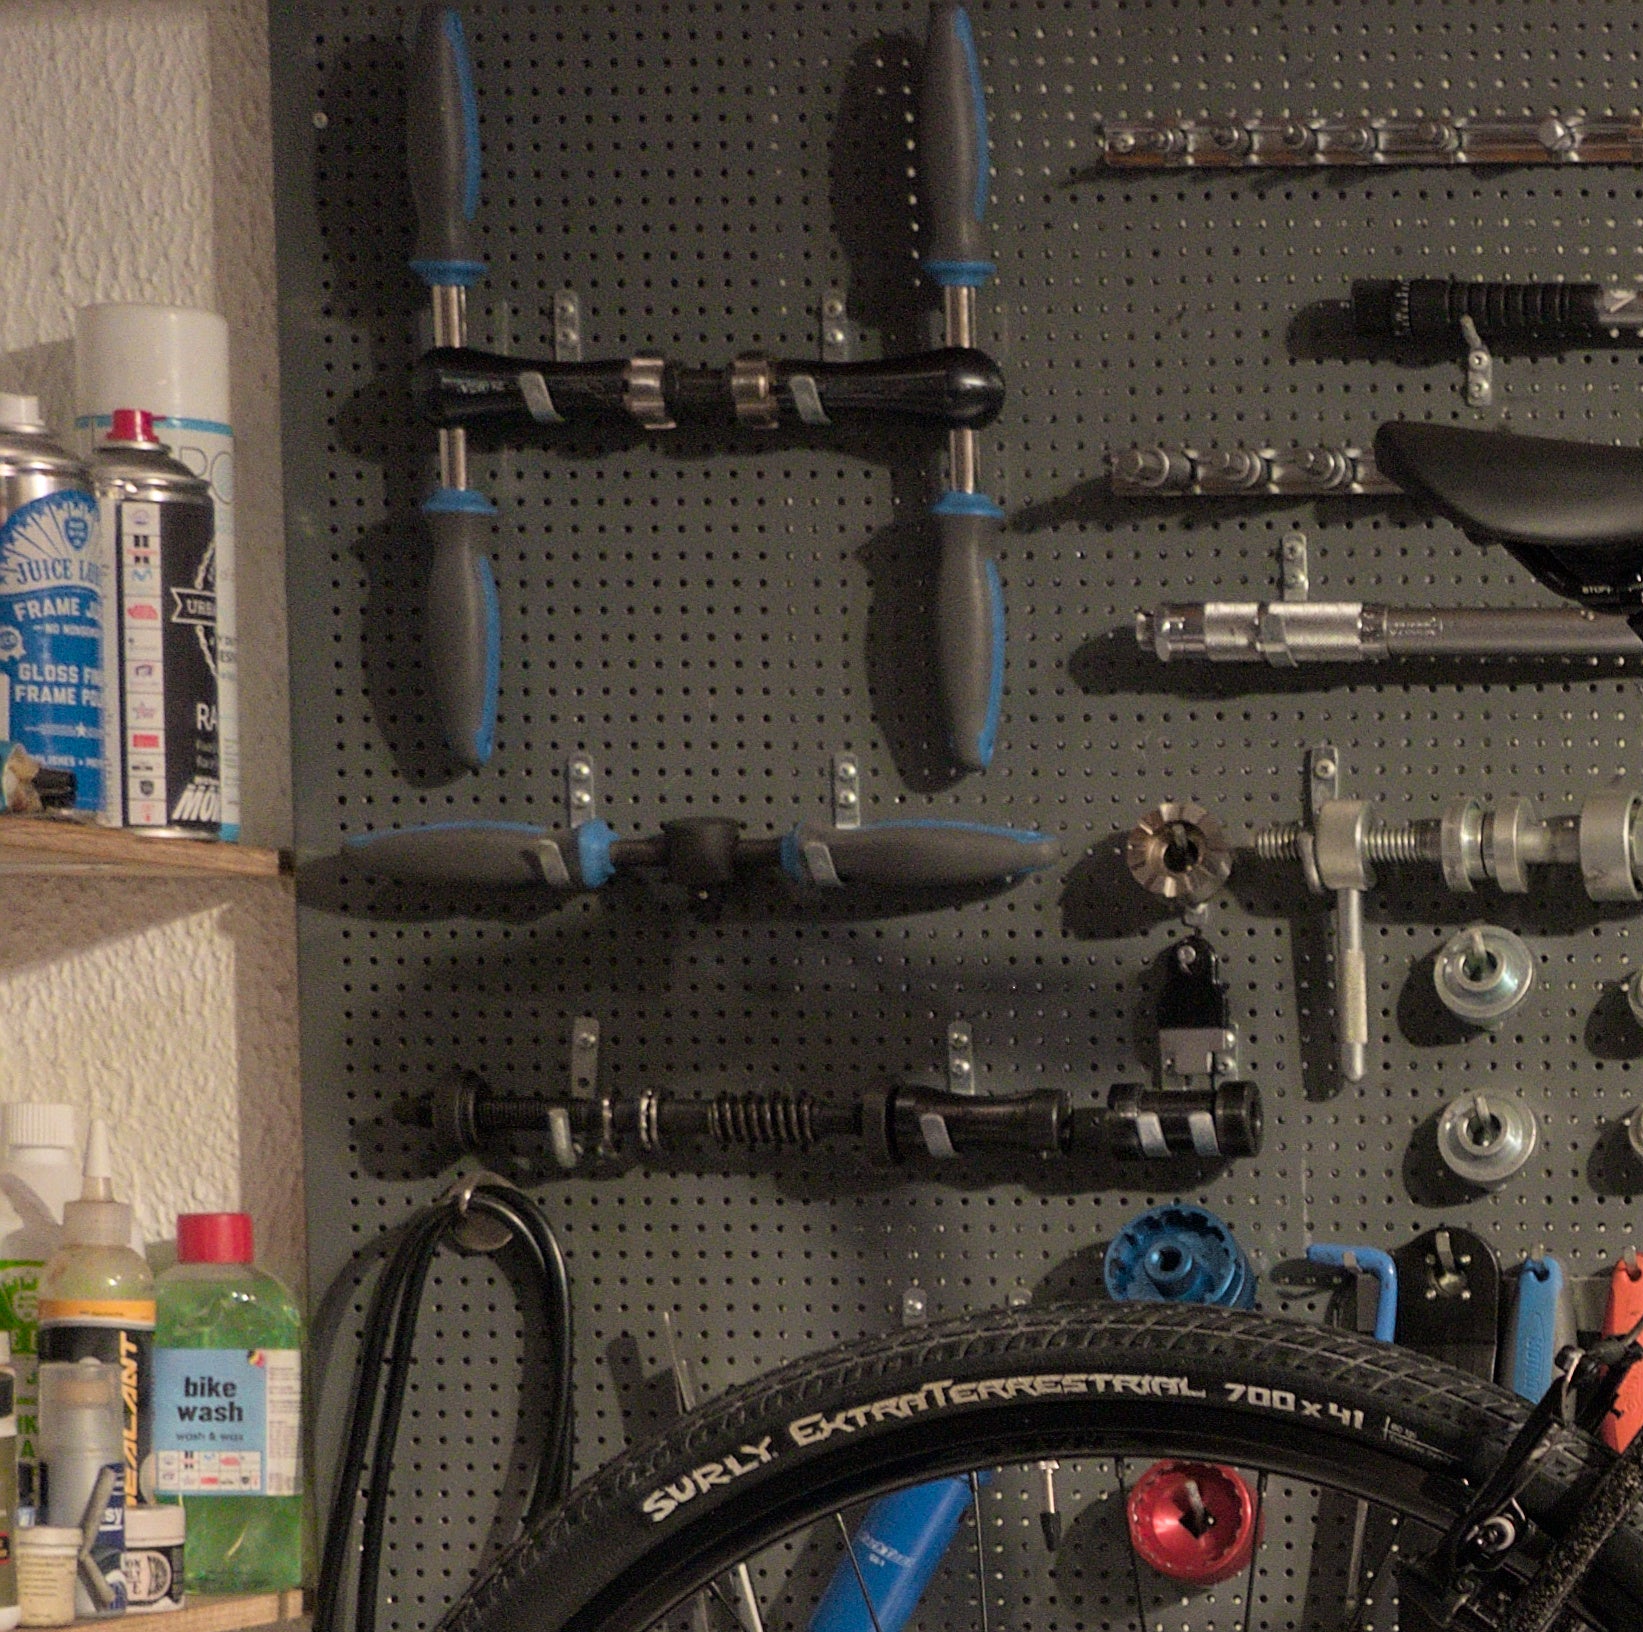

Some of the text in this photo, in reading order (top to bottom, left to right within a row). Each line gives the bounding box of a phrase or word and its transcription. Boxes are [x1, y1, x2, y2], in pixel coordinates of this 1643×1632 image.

[16, 556, 72, 585] JUICE
[13, 598, 80, 622] FRAME
[18, 662, 79, 685] GLOSS
[14, 686, 77, 706] FRAME
[184, 1376, 237, 1398] bike
[177, 1402, 244, 1422] wash
[641, 1434, 776, 1524] SURLY
[1224, 1381, 1296, 1414] 700
